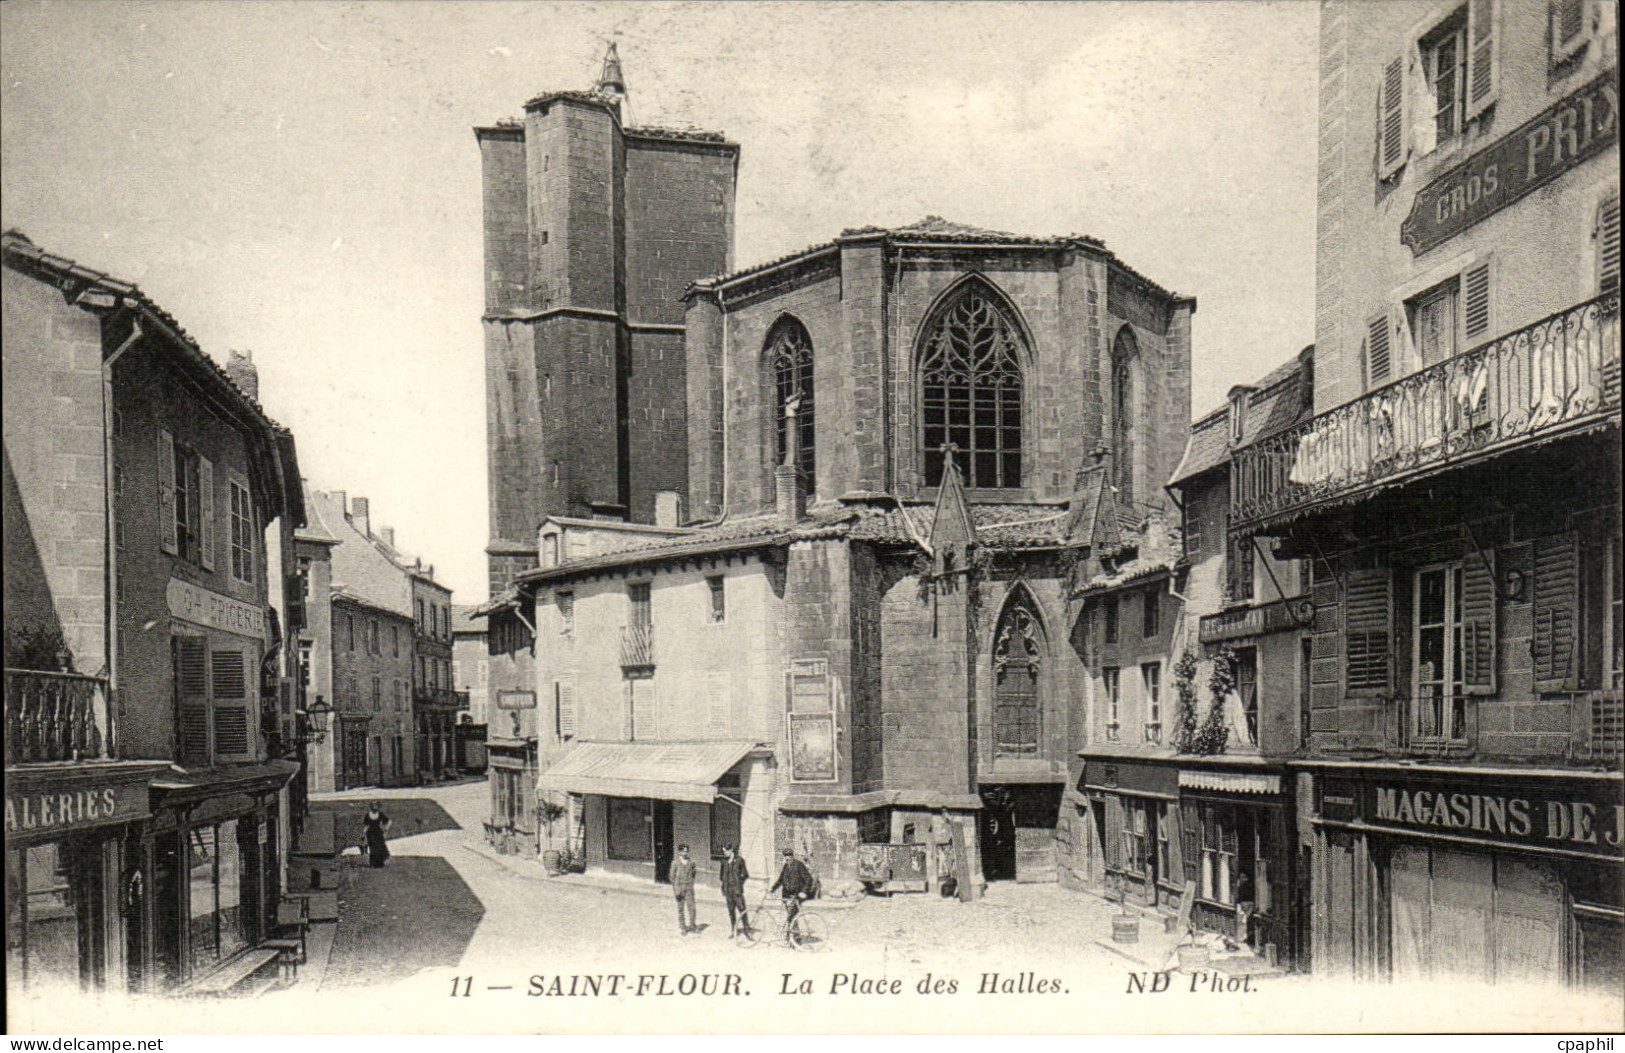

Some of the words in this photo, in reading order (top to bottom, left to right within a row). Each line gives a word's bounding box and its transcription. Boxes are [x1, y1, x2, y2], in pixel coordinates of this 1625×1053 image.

[1436, 163, 1498, 224] GROS
[5, 788, 115, 832] ALERIES
[1375, 787, 1532, 836] MAGASINS
[1544, 800, 1597, 845] DE
